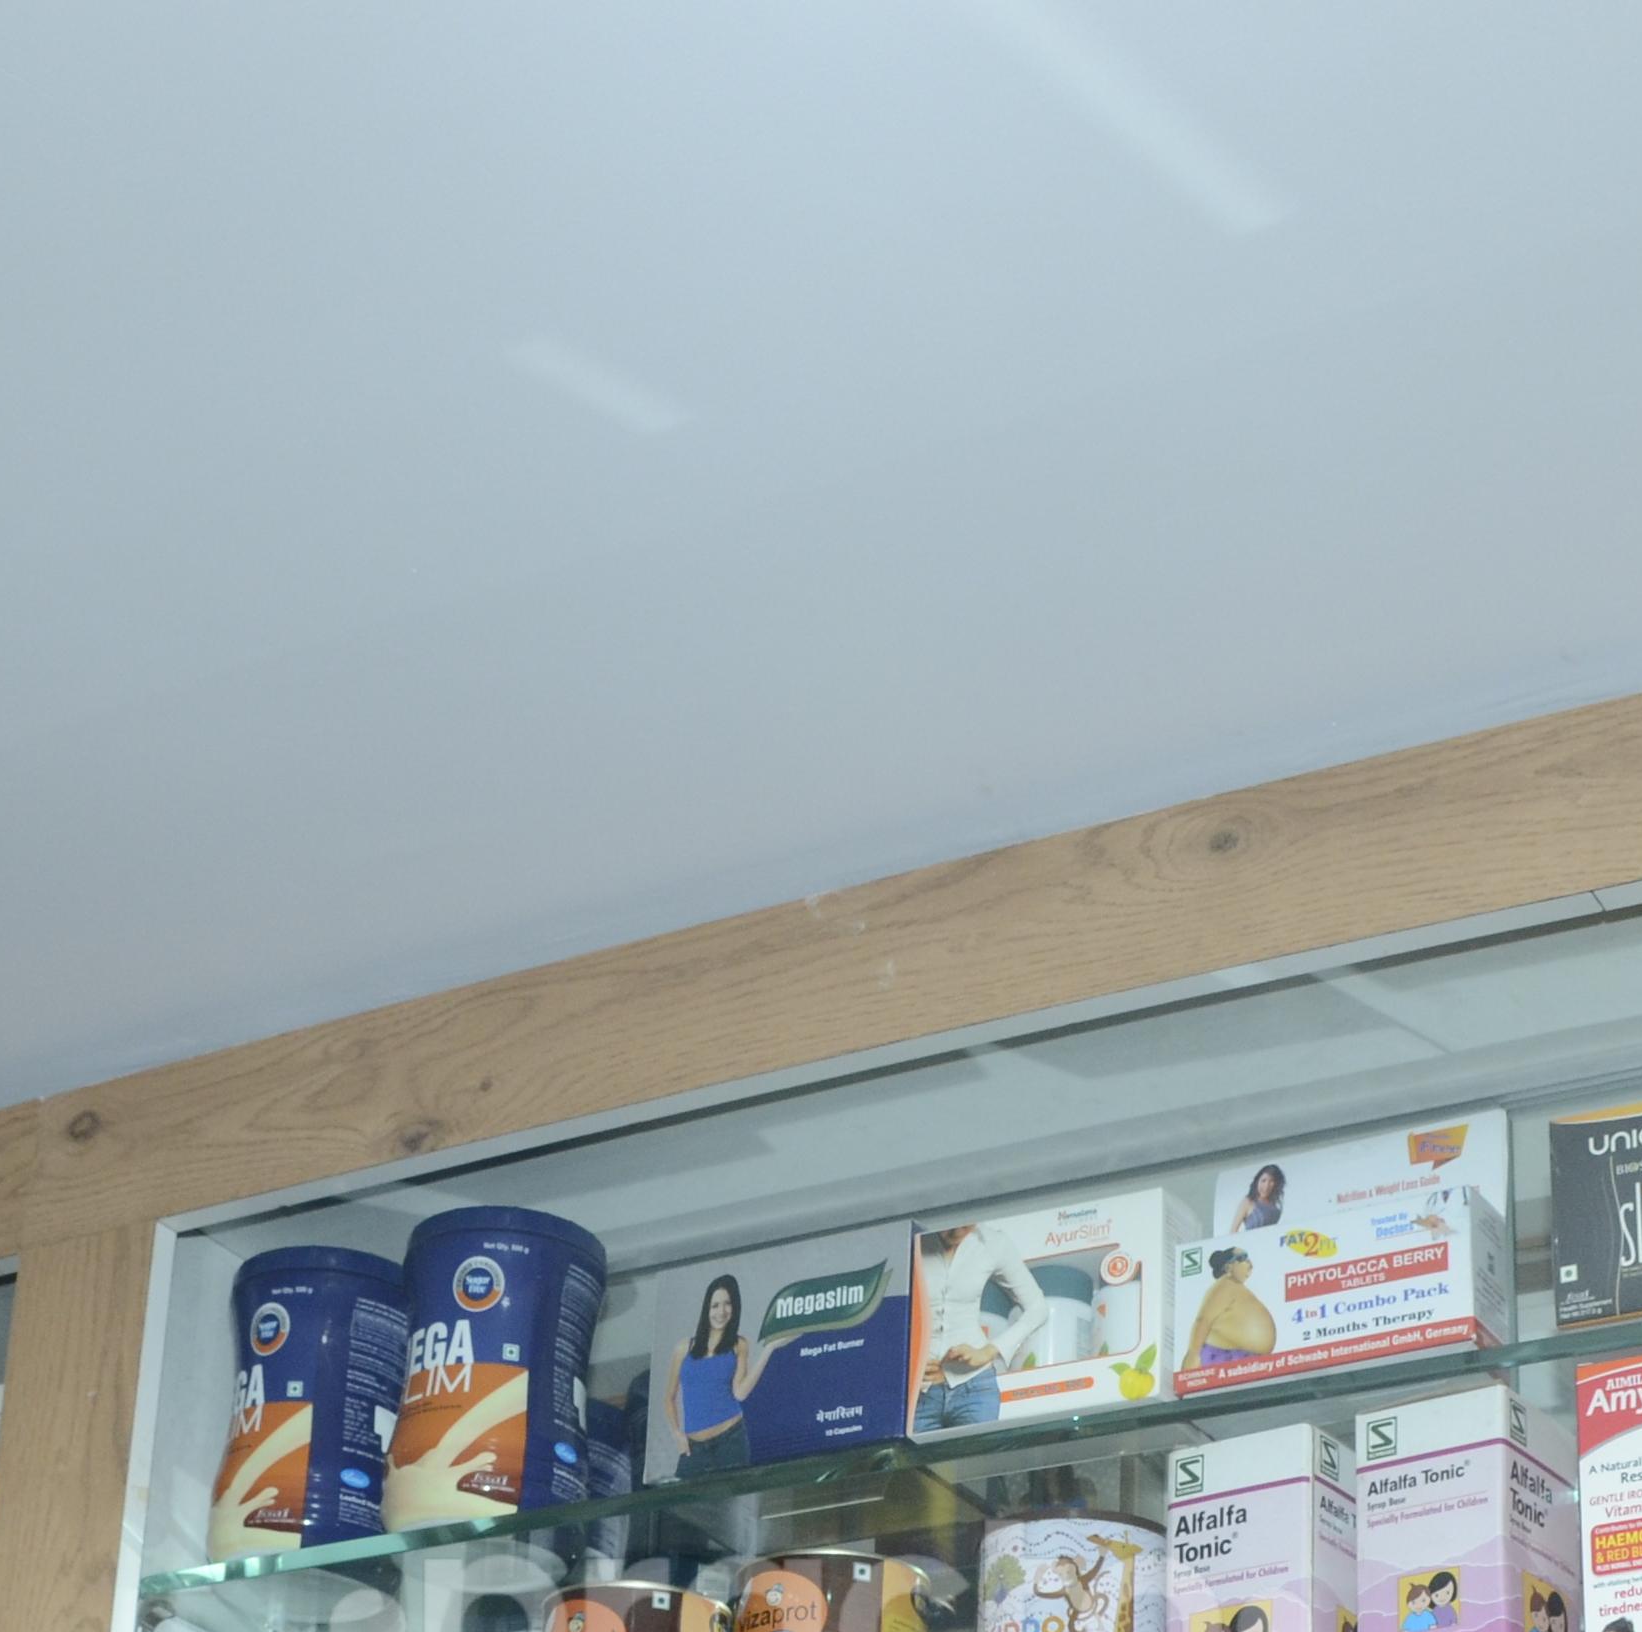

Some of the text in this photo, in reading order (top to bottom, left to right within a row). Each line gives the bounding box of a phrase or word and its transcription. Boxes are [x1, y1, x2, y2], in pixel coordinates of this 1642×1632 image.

[1045, 1224, 1112, 1246] AyurSlim
[1287, 1247, 1444, 1288] PHYTOLACCA BERRY
[1341, 1273, 1386, 1288] TABLETS
[776, 1285, 864, 1319] Megaslim
[1334, 1293, 1396, 1315] Combo
[1403, 1282, 1449, 1301] Pack
[1316, 1321, 1368, 1339] Months
[1375, 1308, 1435, 1329] Therapy
[408, 1320, 474, 1380] EGA
[800, 1339, 864, 1357] Mega Fat Burner
[1227, 1360, 1273, 1378] subsidiary
[1275, 1358, 1286, 1368] of
[1287, 1350, 1329, 1366] Schwabe
[1331, 1337, 1390, 1358] International
[1426, 1325, 1469, 1341] Germany
[1368, 1464, 1465, 1496] Alfalfa Tonic
[1589, 1466, 1597, 1474] A
[1601, 1458, 1642, 1472] Natural
[1510, 1461, 1553, 1504] Alfalfa
[1175, 1504, 1247, 1538] Alfalfa
[1510, 1488, 1544, 1527] Tonic
[1175, 1536, 1232, 1564] Tonic
[1596, 1552, 1604, 1564] &
[1607, 1549, 1629, 1562] RED
